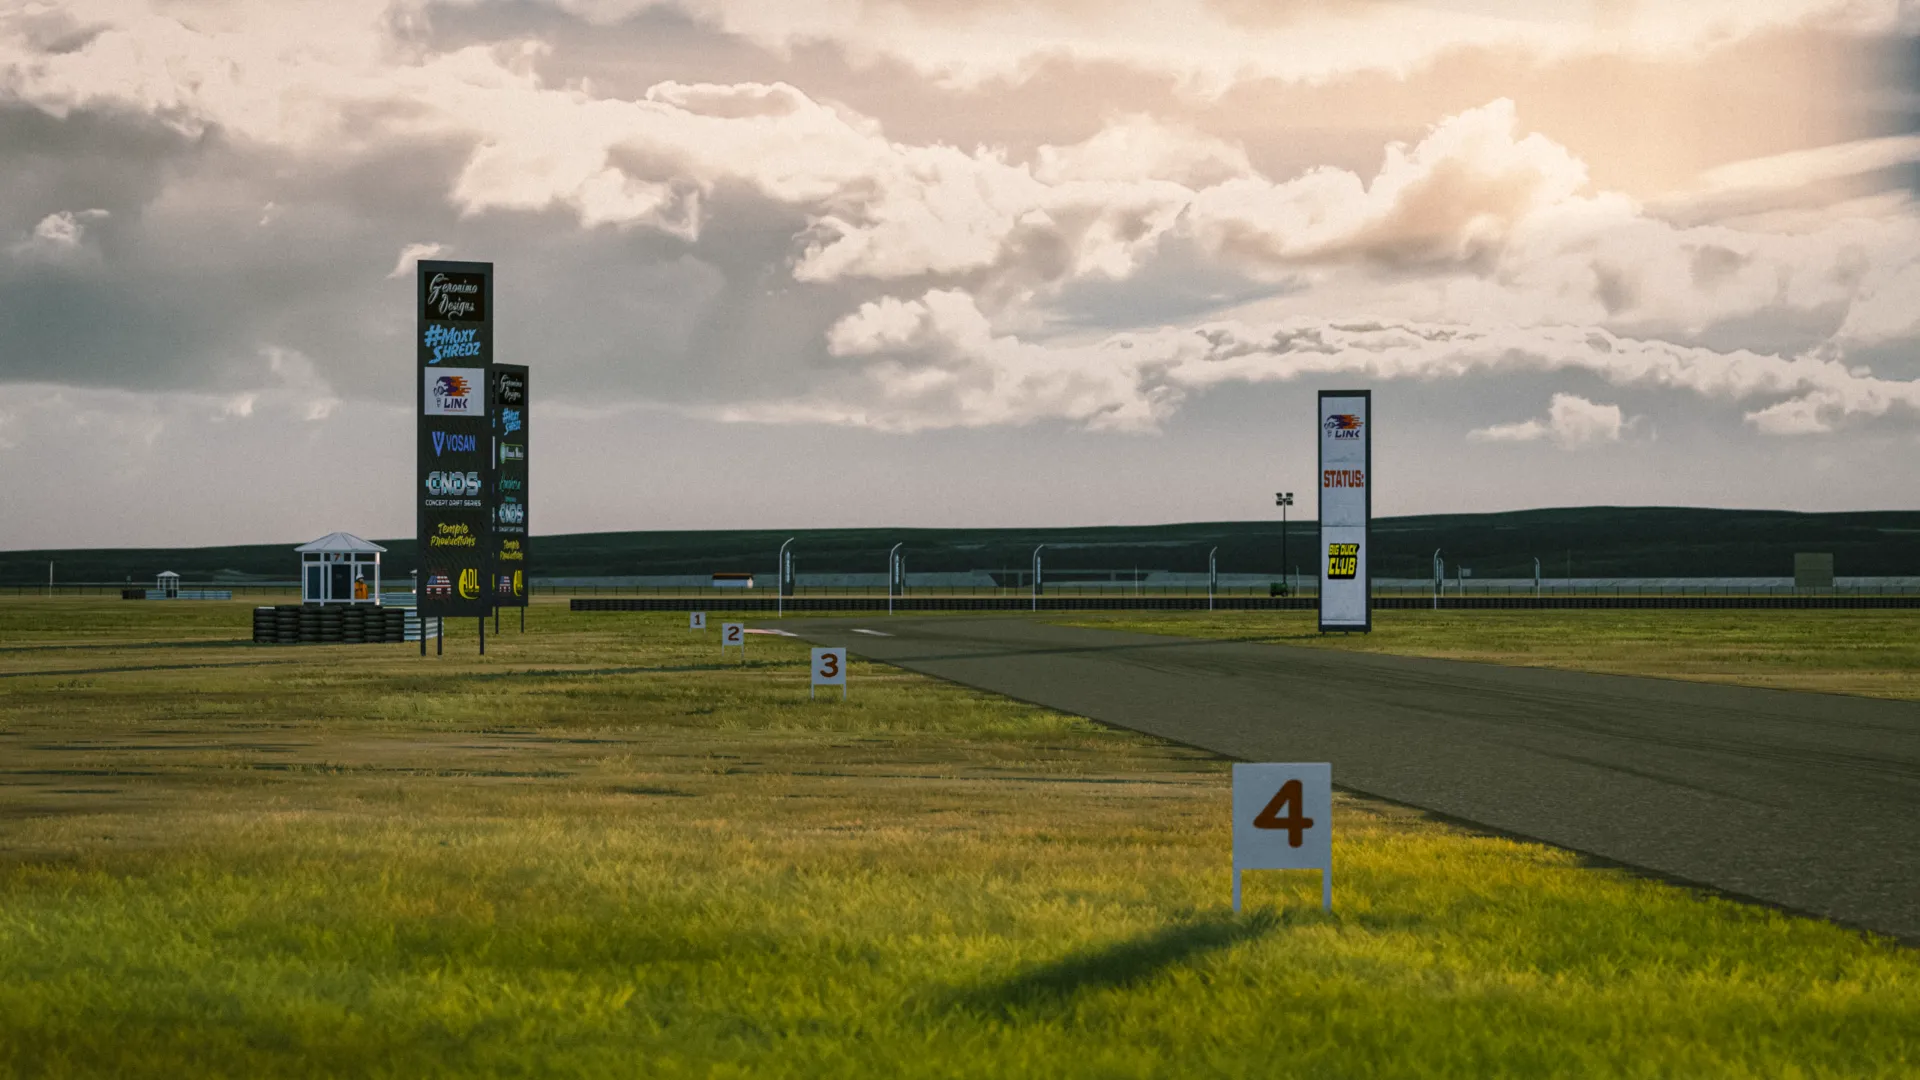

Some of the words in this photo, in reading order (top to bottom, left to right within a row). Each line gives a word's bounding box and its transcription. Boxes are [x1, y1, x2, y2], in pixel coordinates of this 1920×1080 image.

[428, 273, 478, 305] Geronimo
[439, 293, 475, 320] Designs
[424, 324, 477, 347] #MOXY
[428, 341, 481, 364] SHREDZ
[444, 398, 468, 409] LINK
[446, 434, 476, 452] VOSAN
[1335, 430, 1360, 438] LINK
[438, 522, 469, 538] Temple
[1328, 544, 1340, 555] BIG
[1328, 557, 1356, 576] CLUB
[694, 614, 702, 626] 1
[727, 626, 740, 641] 2
[819, 653, 839, 678] 3
[1253, 779, 1314, 849] 4
